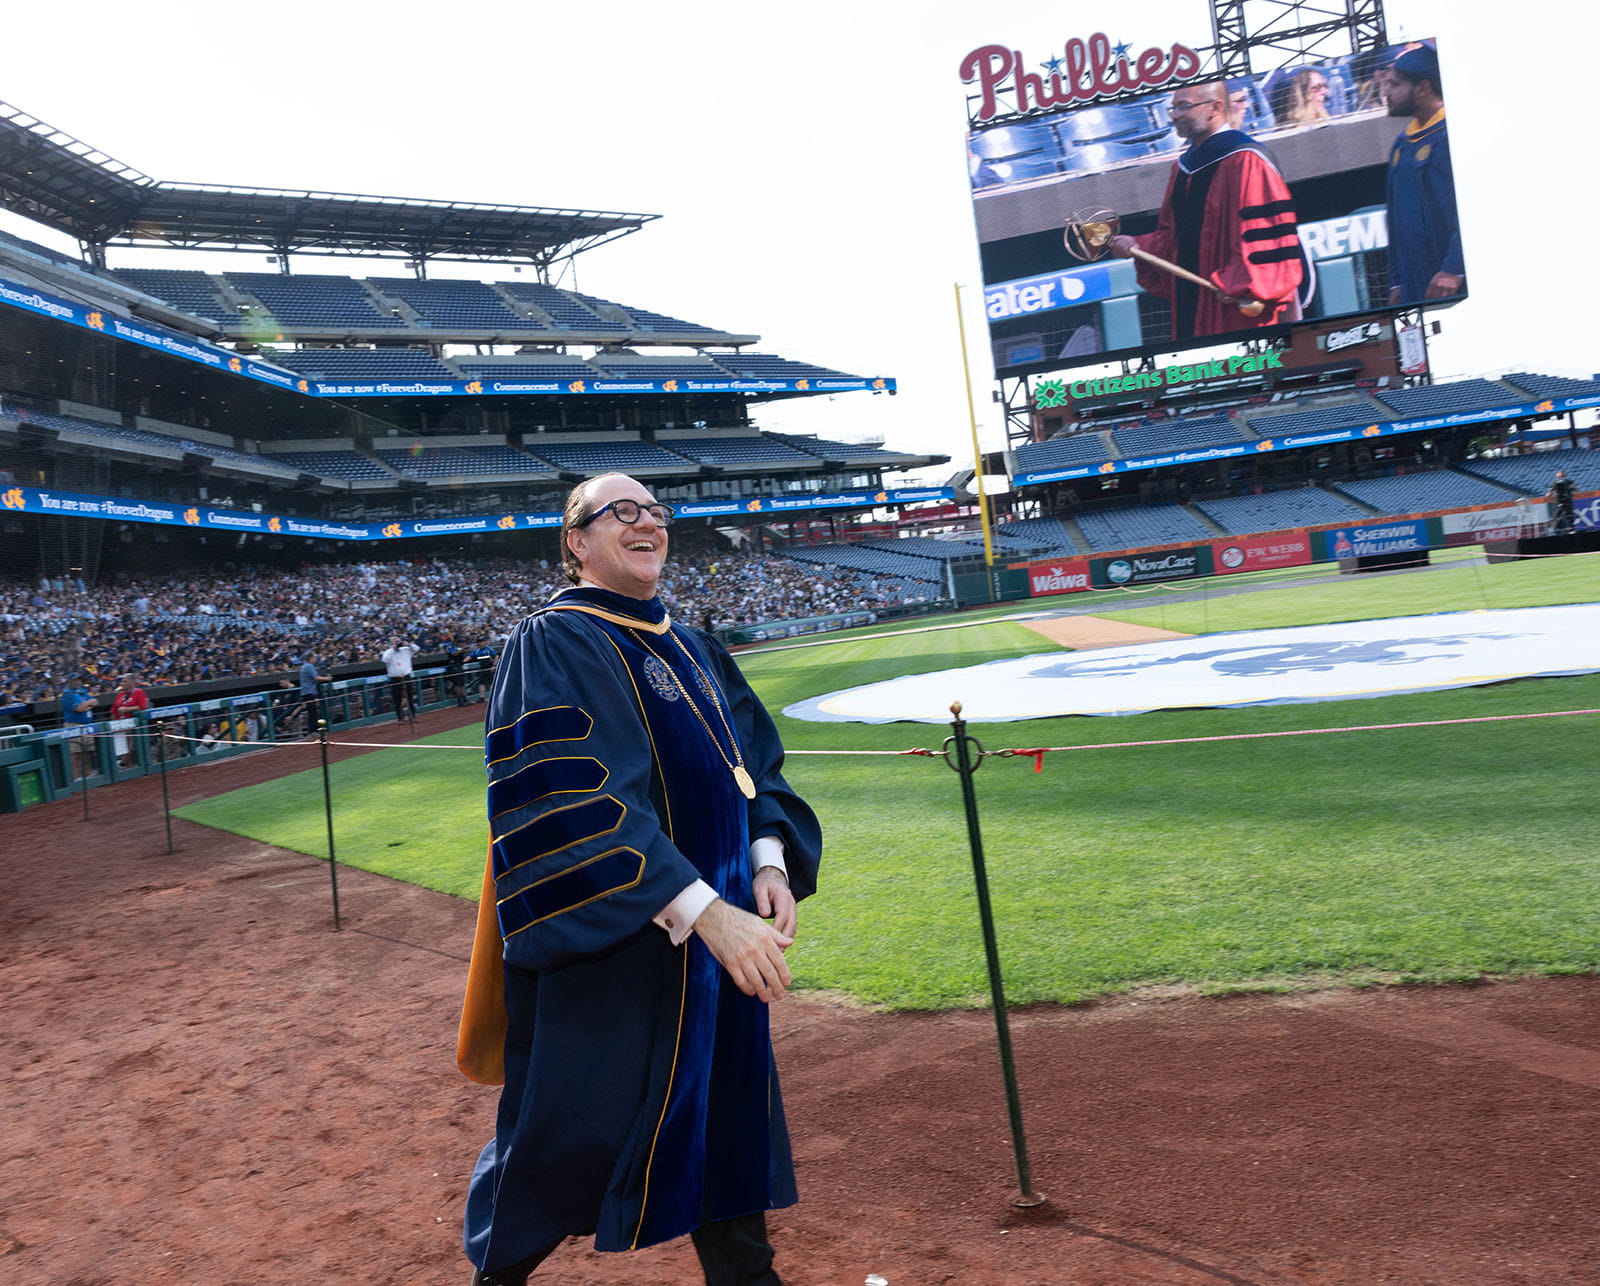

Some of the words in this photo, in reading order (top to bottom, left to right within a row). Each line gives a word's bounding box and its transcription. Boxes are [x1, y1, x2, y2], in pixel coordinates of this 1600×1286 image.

[959, 31, 1201, 121] Phillies
[986, 281, 1056, 319] ater
[1070, 371, 1163, 399] Citizens
[1165, 358, 1226, 385] Bank
[1227, 349, 1284, 375] Park
[316, 384, 336, 394] You
[337, 385, 353, 393] are
[354, 385, 375, 394] now
[376, 383, 453, 395] #ForeverDragons
[493, 382, 559, 391] Commencement
[593, 381, 654, 391] Commencement
[686, 381, 701, 390] You
[702, 382, 714, 390] are
[816, 380, 866, 388] Commencement
[1391, 422, 1410, 431] You
[1410, 421, 1425, 429] are
[1425, 418, 1444, 427] now
[1283, 431, 1352, 447] Commencement
[1125, 460, 1142, 469] You
[1142, 459, 1155, 467] are
[1156, 456, 1174, 465] now
[1026, 467, 1089, 482] Commencement
[38, 493, 60, 508] You
[61, 500, 78, 510] are
[79, 501, 100, 512] now
[681, 504, 739, 514] Commencement
[413, 520, 487, 533] Commencement
[526, 515, 544, 526] You
[544, 516, 559, 524] are
[1353, 525, 1416, 542] SHERWIN
[1133, 555, 1196, 572] NovaCare
[1032, 573, 1088, 592] Wawa
